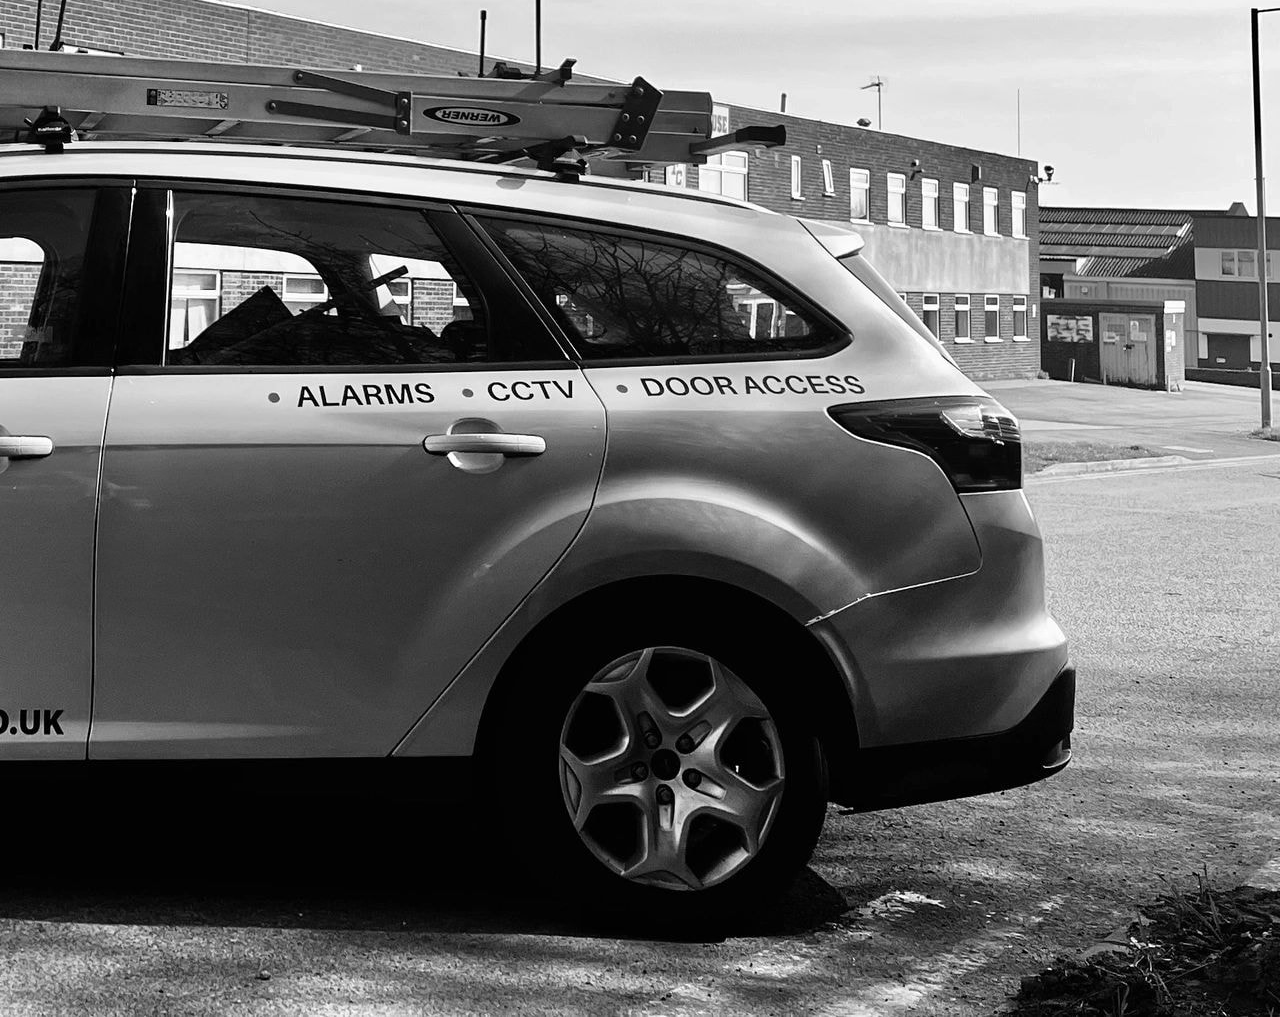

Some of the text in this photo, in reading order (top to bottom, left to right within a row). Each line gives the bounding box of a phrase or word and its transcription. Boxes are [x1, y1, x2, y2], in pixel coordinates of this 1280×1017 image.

[440, 109, 502, 124] WERNER
[297, 383, 435, 407] ALARMS
[486, 381, 575, 401] CCTV
[640, 375, 865, 397] DOOR ACCESS
